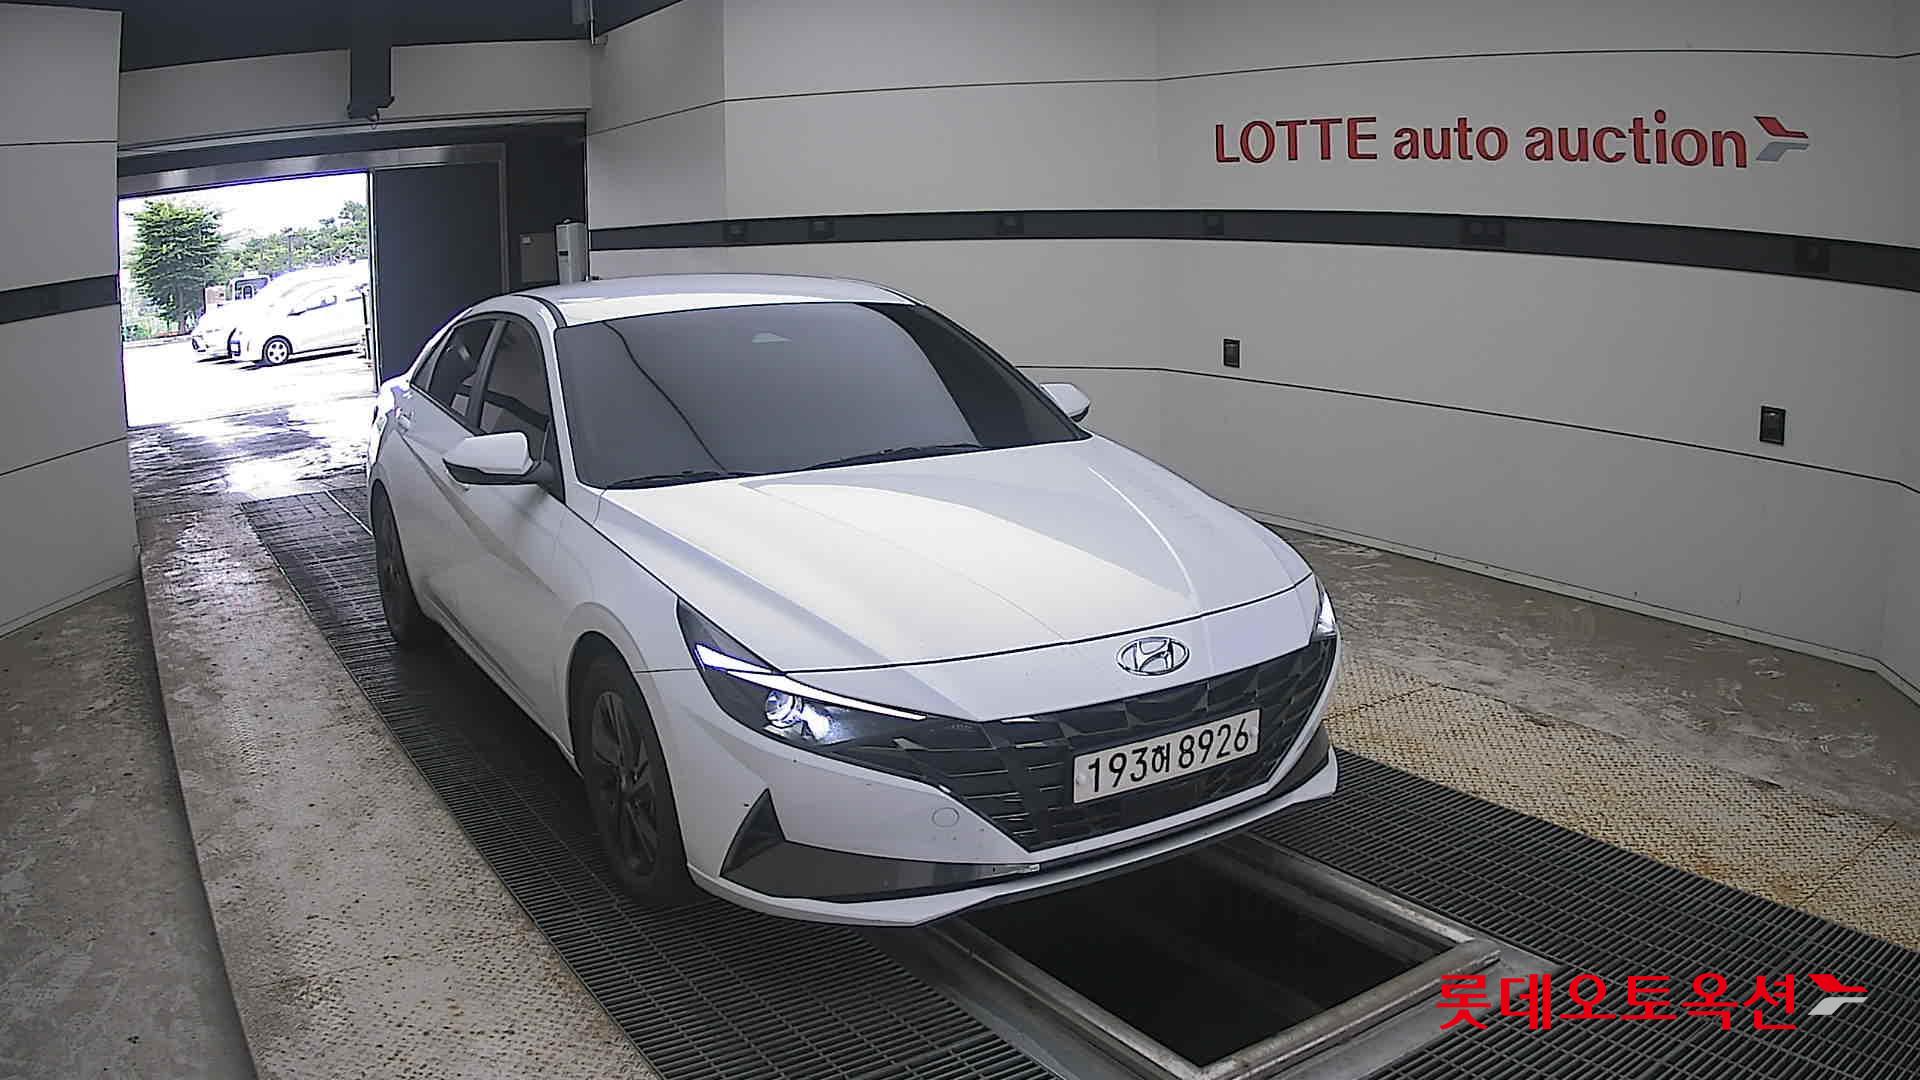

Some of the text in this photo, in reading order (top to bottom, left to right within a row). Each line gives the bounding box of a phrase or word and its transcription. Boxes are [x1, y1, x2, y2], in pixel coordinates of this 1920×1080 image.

[1215, 110, 1747, 168] LOTTE auto auction
[1178, 718, 1249, 769] 8926
